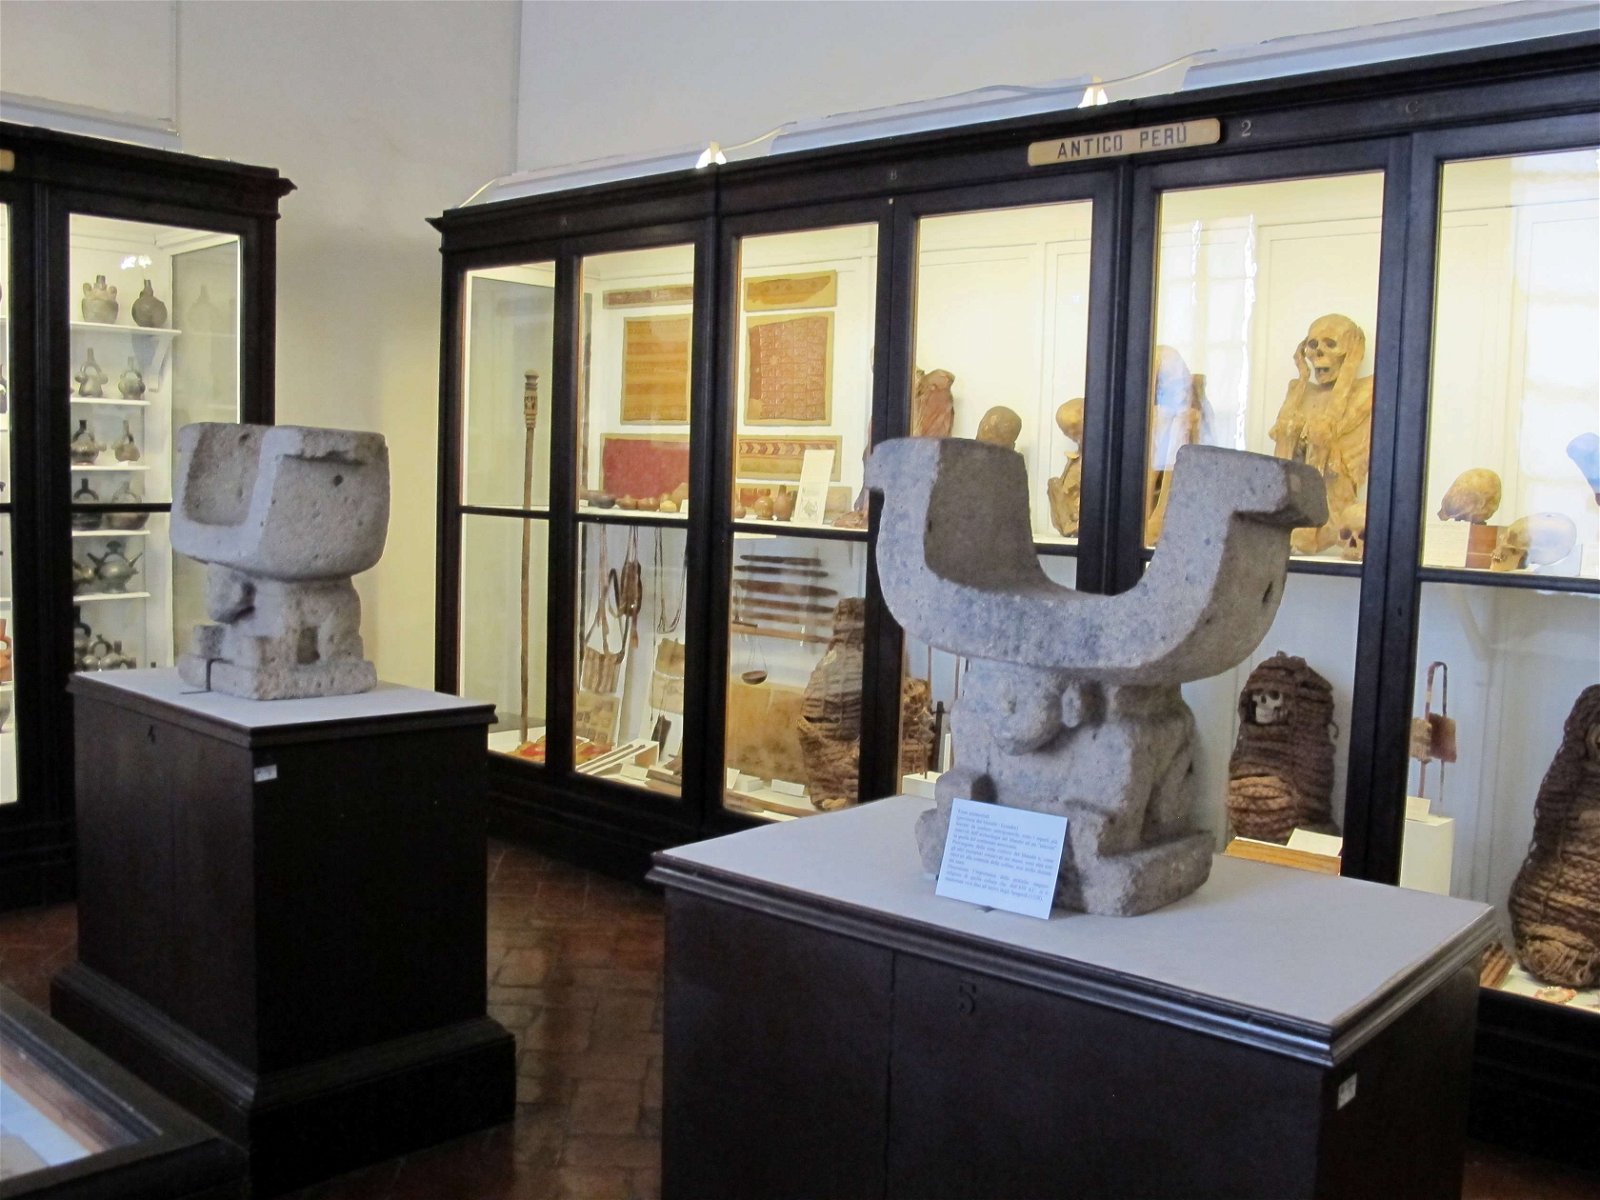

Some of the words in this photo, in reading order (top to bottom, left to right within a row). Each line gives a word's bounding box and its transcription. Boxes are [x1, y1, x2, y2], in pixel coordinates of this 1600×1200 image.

[1057, 134, 1123, 159] ANTICO
[1139, 122, 1187, 148] PERÙ
[1241, 119, 1252, 137] 2
